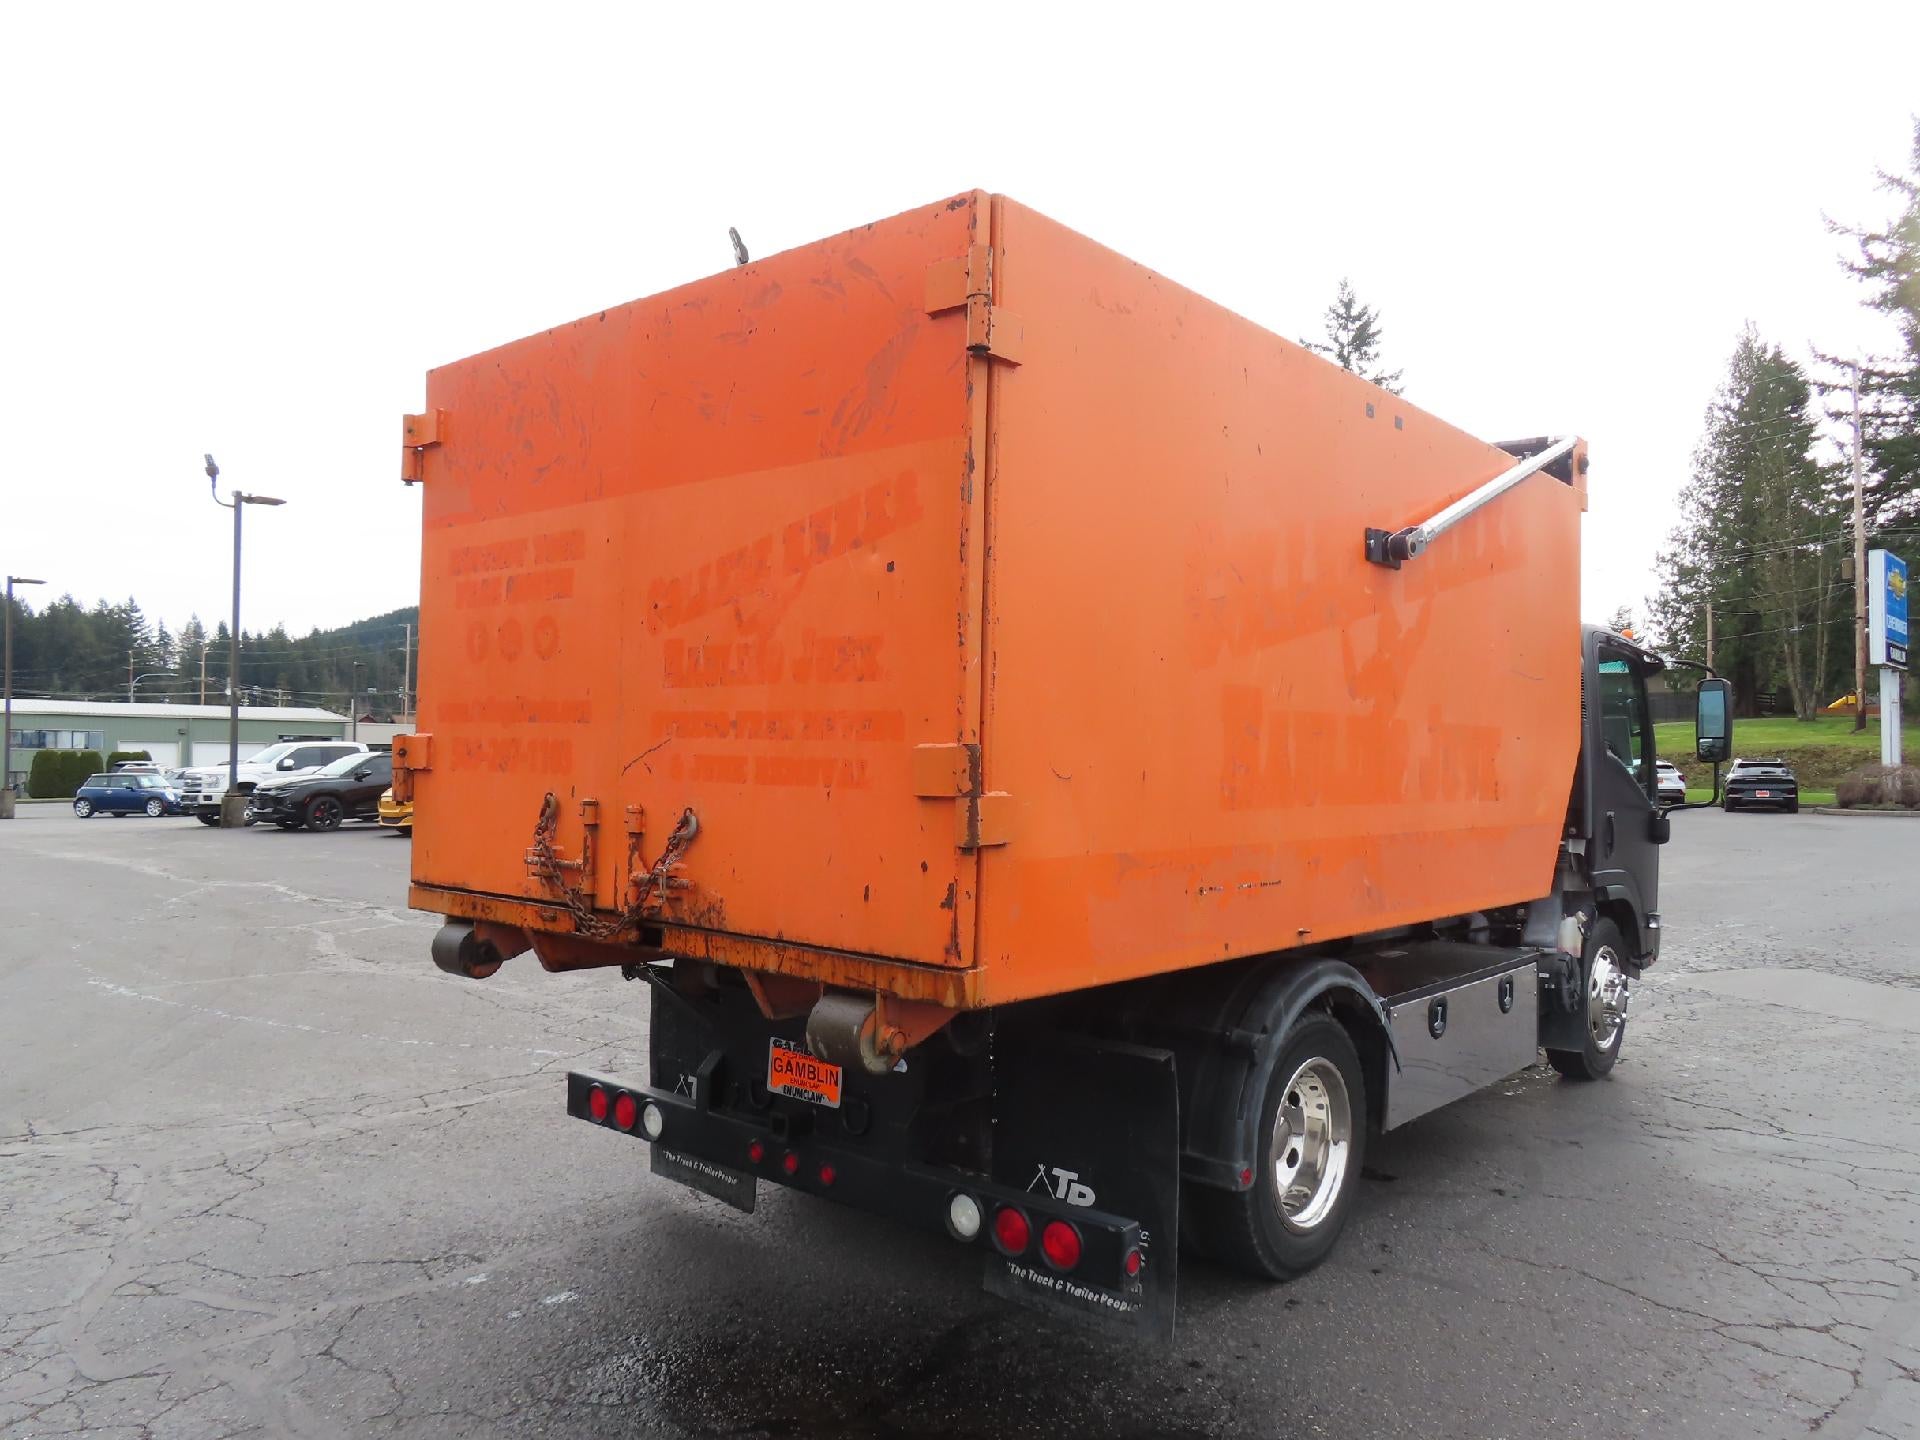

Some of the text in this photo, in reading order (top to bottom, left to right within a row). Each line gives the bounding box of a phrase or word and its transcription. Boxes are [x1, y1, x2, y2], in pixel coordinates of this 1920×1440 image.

[773, 1057, 839, 1087] GAMBLIN
[1028, 1269, 1054, 1289] Truck
[1055, 1279, 1064, 1290] &
[1065, 1282, 1100, 1302] Trailer
